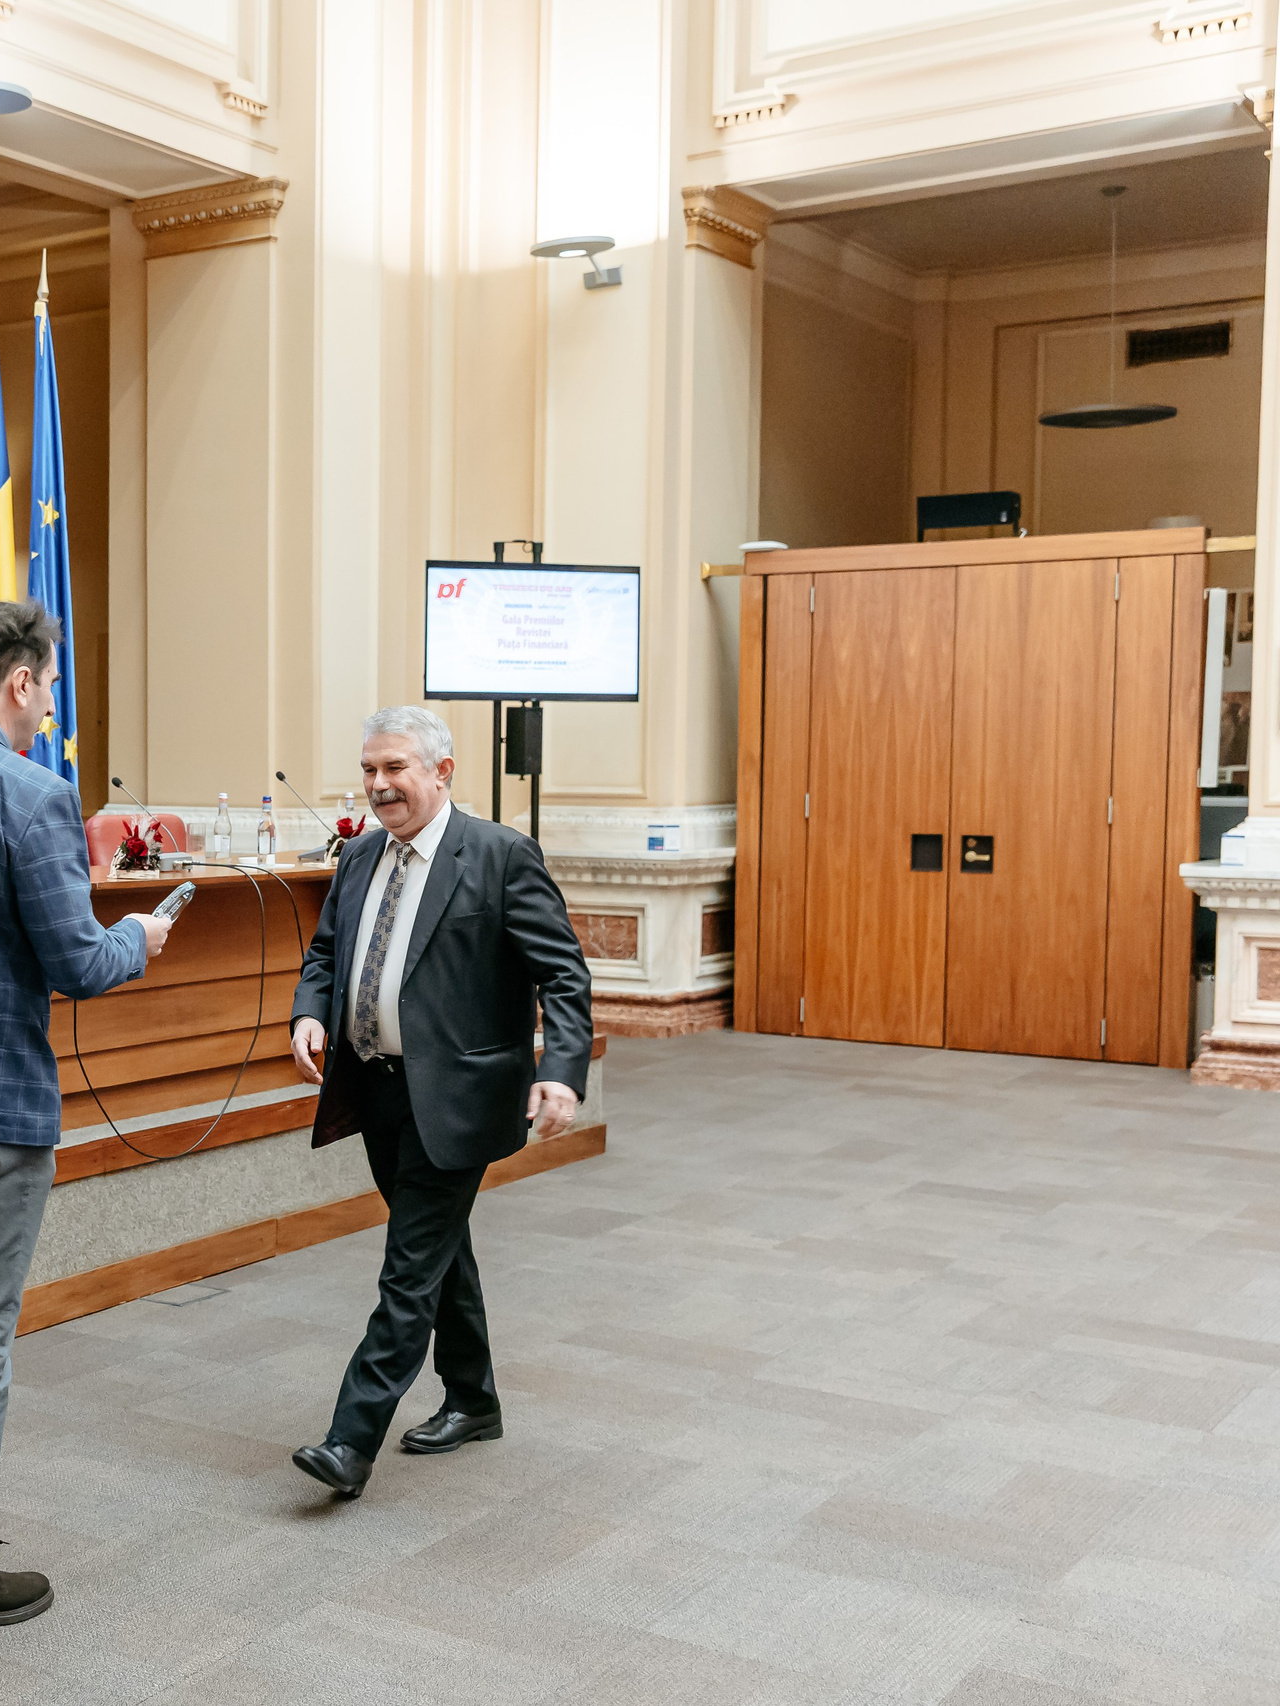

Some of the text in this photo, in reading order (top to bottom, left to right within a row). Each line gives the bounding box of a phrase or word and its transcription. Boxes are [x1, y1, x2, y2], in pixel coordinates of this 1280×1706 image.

[437, 578, 467, 599] pf
[502, 614, 521, 625] Gala
[516, 627, 551, 638] Revistei
